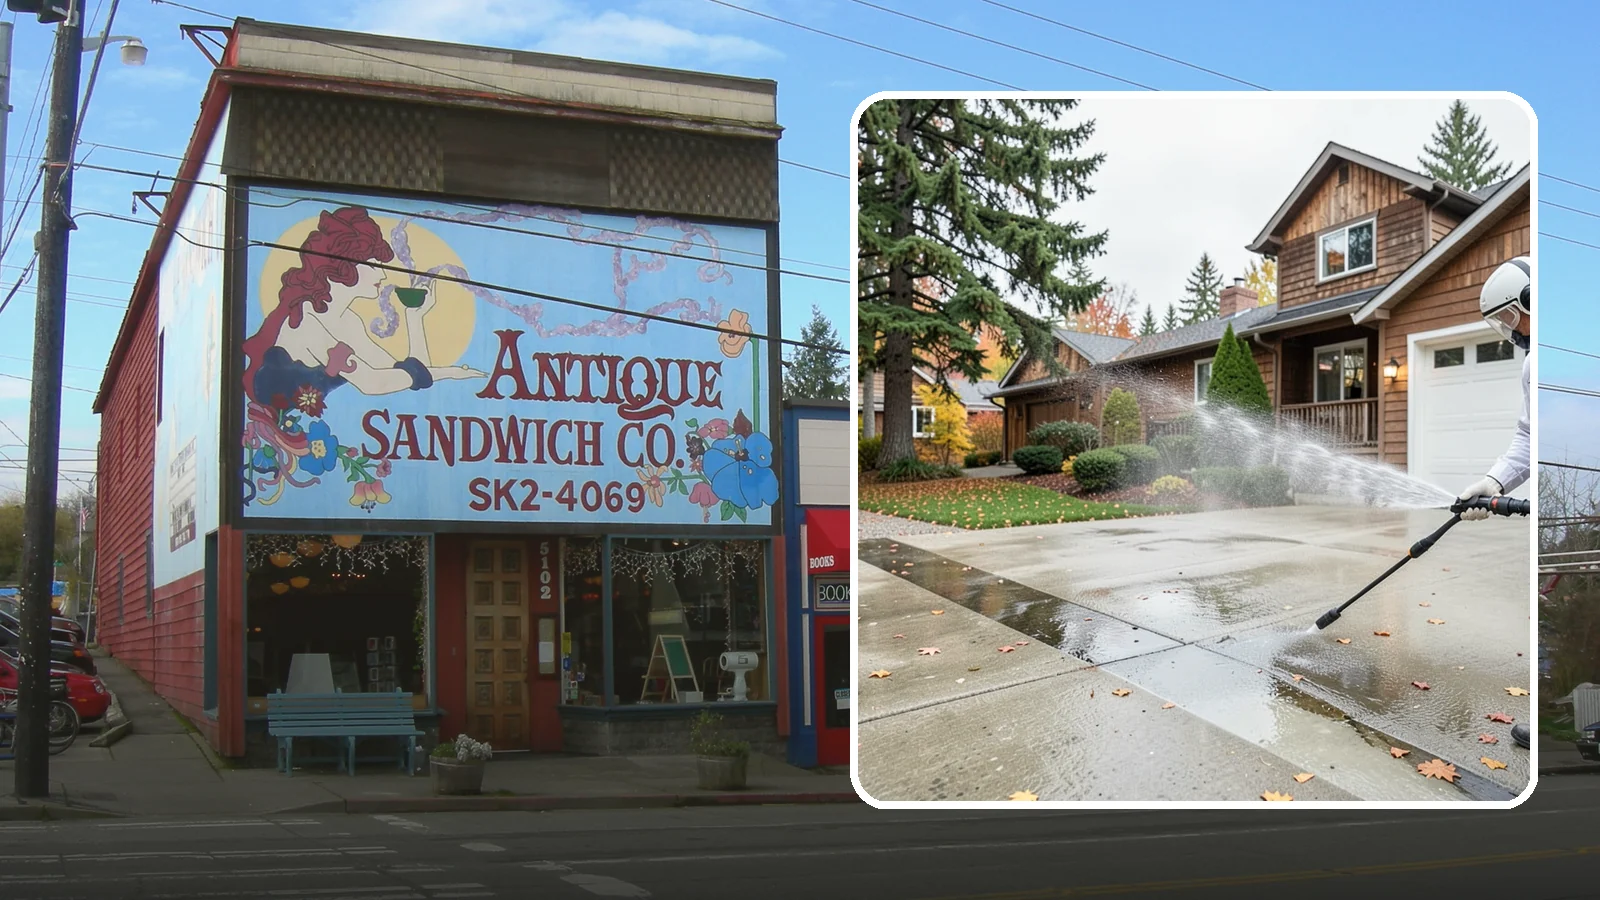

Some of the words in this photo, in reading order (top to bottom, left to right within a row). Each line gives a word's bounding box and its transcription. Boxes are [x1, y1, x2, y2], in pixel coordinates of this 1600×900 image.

[477, 330, 723, 421] ANTIQUE
[362, 409, 604, 467] SANDWICH
[617, 422, 685, 469] CO.
[469, 477, 645, 512] SK2-4069
[540, 542, 551, 599] 5102
[809, 555, 834, 568] BOOKS
